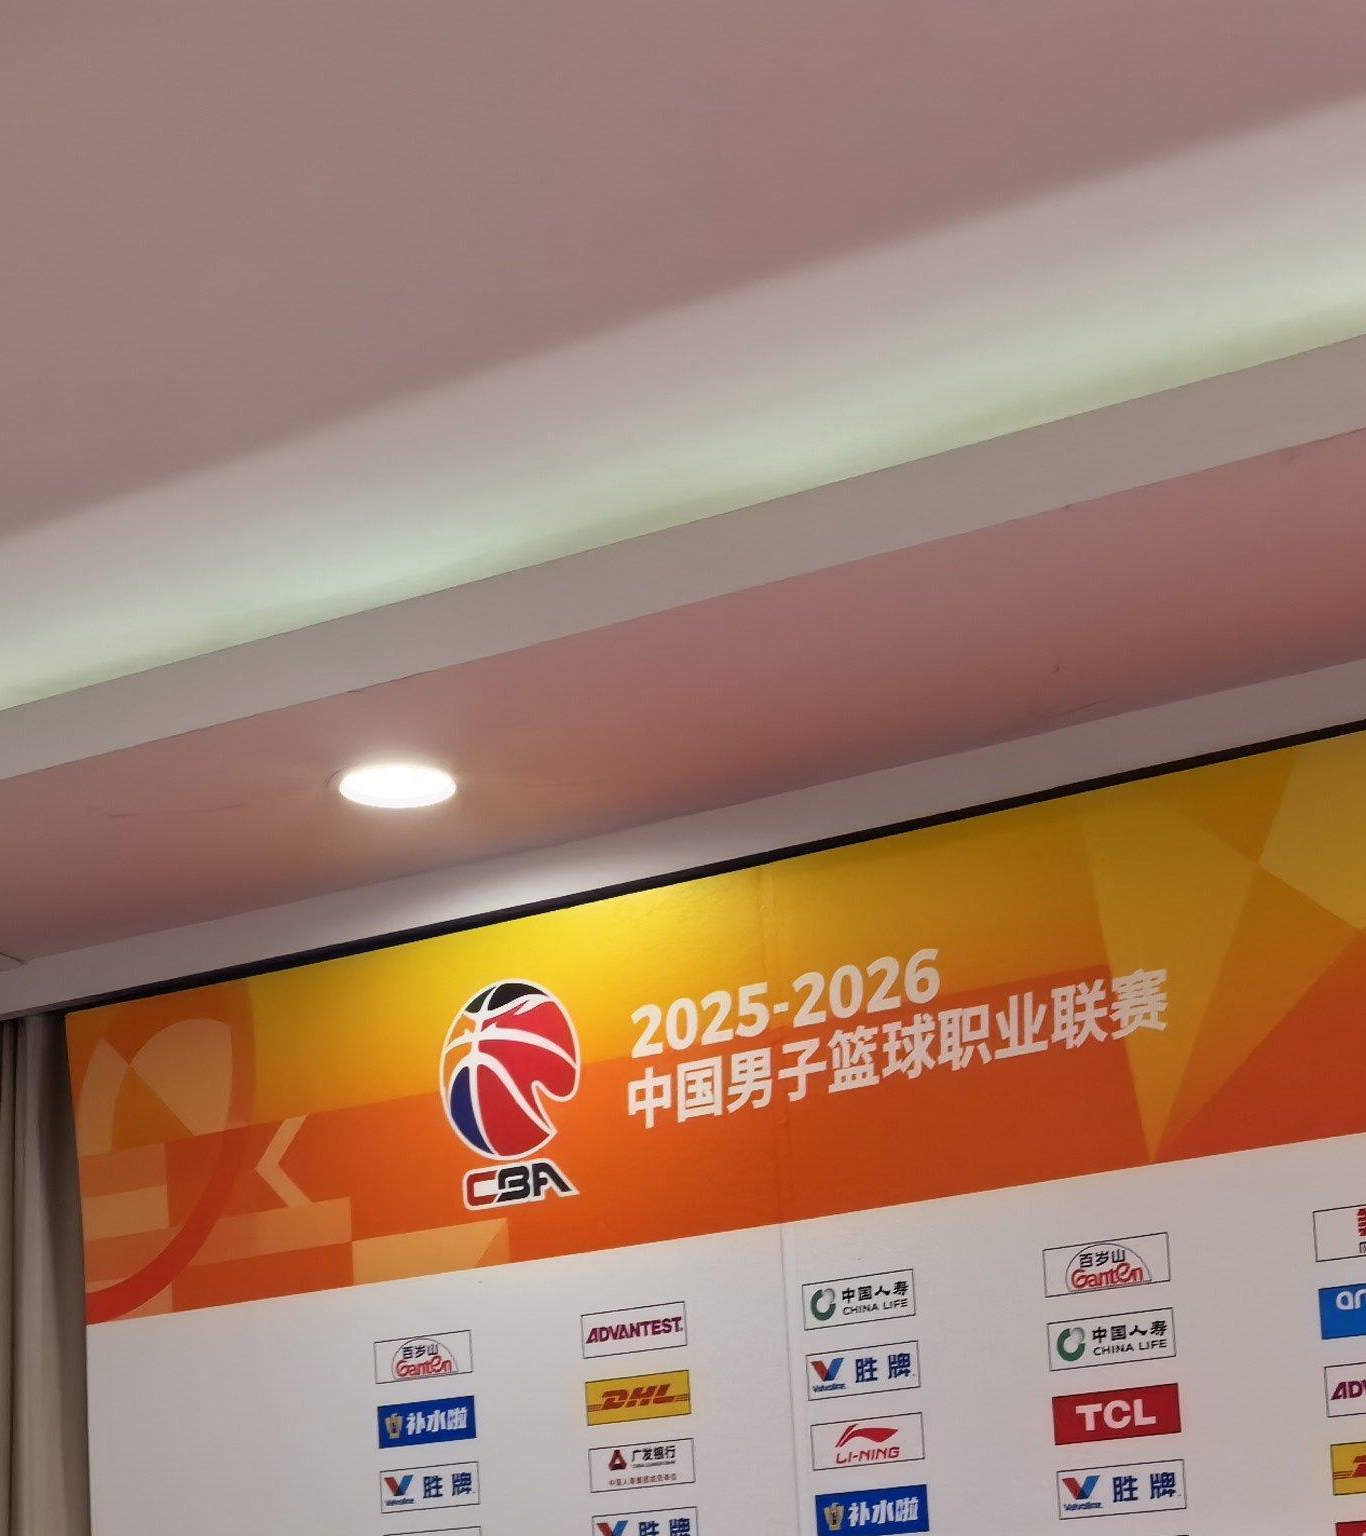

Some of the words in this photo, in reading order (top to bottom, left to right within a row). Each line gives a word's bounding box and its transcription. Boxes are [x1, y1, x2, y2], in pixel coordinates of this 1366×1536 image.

[631, 948, 941, 1058] 2025-2026
[627, 968, 1169, 1130] 中国男子篮球职业联赛
[465, 1161, 574, 1208] CBA
[1079, 1249, 1125, 1268] 百岁山
[842, 1281, 909, 1303] 中国人寿
[843, 1304, 879, 1315] CHINA
[883, 1298, 908, 1310] LIFE
[586, 1316, 681, 1344] ADVANTEST
[1092, 1320, 1167, 1343] 中国人寿
[403, 1345, 438, 1359] 百岁山
[1093, 1344, 1134, 1356] CHINA
[1139, 1339, 1167, 1350] LIFE
[855, 1353, 911, 1383] 胜牌
[601, 1384, 676, 1410] DHL
[406, 1407, 467, 1435] 补水啦
[1076, 1399, 1156, 1430] TCL
[836, 1447, 900, 1464] LI-NING
[1113, 1472, 1176, 1503] 胜牌
[848, 1497, 918, 1526] 补水啦
